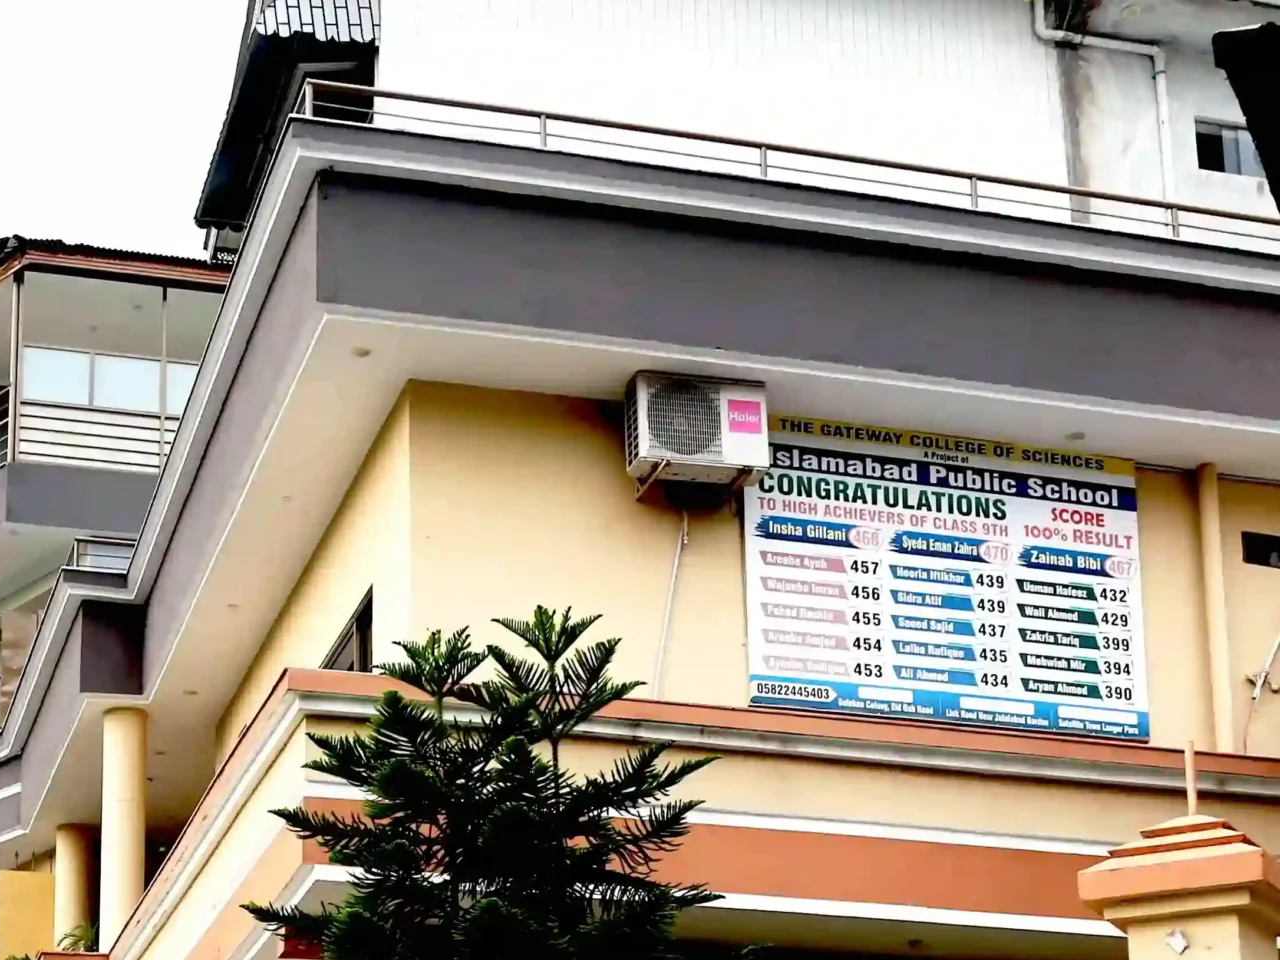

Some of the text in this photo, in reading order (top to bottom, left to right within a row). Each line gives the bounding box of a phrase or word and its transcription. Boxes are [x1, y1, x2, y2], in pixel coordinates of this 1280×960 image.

[729, 411, 760, 423] Haier
[780, 418, 1104, 471] THE GATEWAY COLLEGE OF SCIENCES
[931, 452, 959, 463] Project
[961, 456, 969, 464] of
[930, 465, 1017, 494] Public
[1027, 478, 1118, 507] School
[758, 472, 1007, 520] CONGRATULATIONS
[758, 497, 1008, 537] TO HIGH ACHIEVERS OF CLASS 9TH
[1051, 507, 1105, 528] SCORE
[769, 520, 802, 536] Insha
[807, 524, 846, 541] Gillani
[1024, 525, 1133, 549] 100% RESULT
[902, 536, 1008, 561] Syeda Eman Zahra 470
[850, 560, 879, 575] 457
[1031, 551, 1132, 575] Zainab Bibi 467
[976, 574, 1004, 588] 439
[851, 586, 880, 600] 456
[1024, 582, 1053, 594] Usman
[1100, 588, 1127, 602] 432
[897, 592, 1005, 613] Sidra Atif 439
[852, 611, 881, 626] 455
[1048, 608, 1078, 621] Ahmed
[1101, 613, 1128, 627] 429
[979, 623, 1005, 638] 437
[853, 637, 882, 652] 454
[1057, 634, 1079, 647] Tariq
[1103, 637, 1129, 651] 399
[980, 648, 1007, 662] 435
[854, 663, 883, 678] 453
[1104, 661, 1130, 676] 394
[981, 673, 1008, 688] 434
[757, 683, 829, 699] 05822445403
[1028, 680, 1054, 693] Aryan
[1105, 686, 1131, 700] 390
